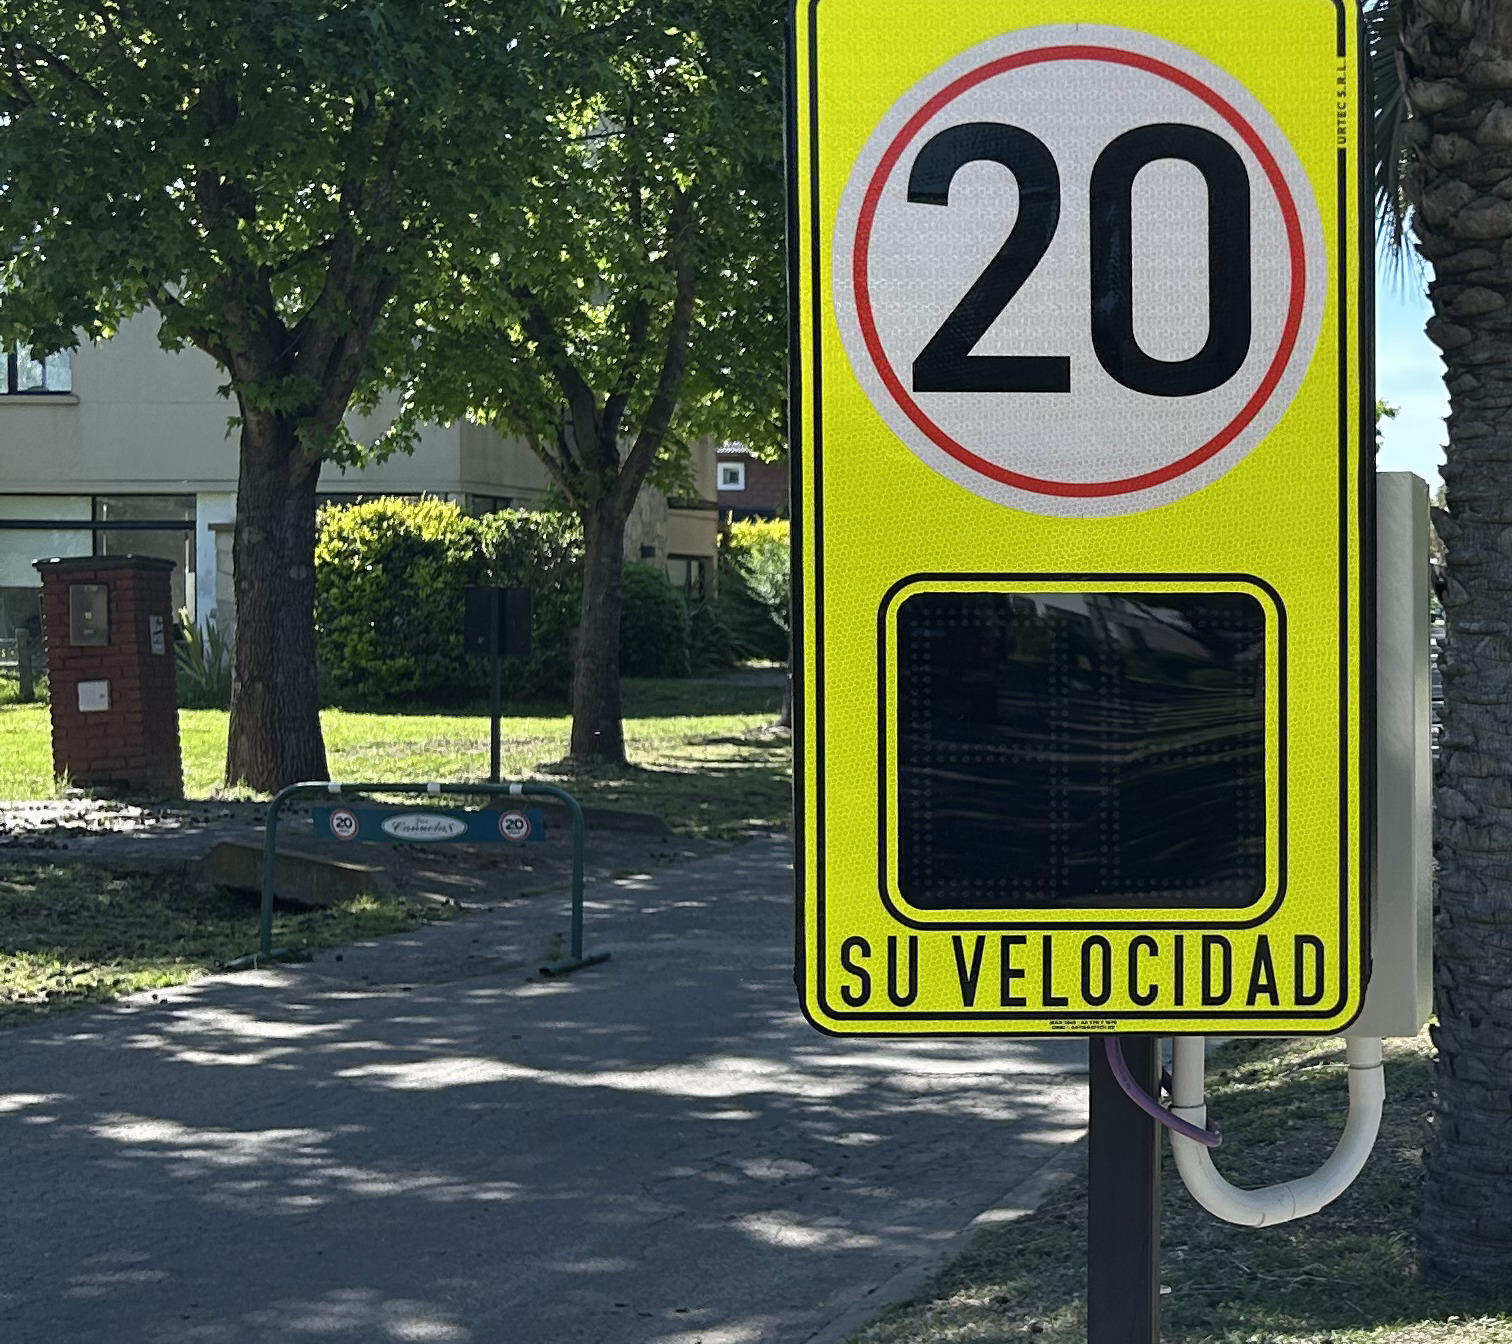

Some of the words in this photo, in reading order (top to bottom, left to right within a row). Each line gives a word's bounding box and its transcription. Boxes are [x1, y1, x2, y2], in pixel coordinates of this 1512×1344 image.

[1336, 101, 1347, 145] URTEC
[905, 120, 1253, 399] 20
[335, 816, 353, 829] 20
[505, 818, 524, 830] 20
[839, 934, 919, 1009] SU
[950, 933, 1326, 1008] VELOCIDAD
